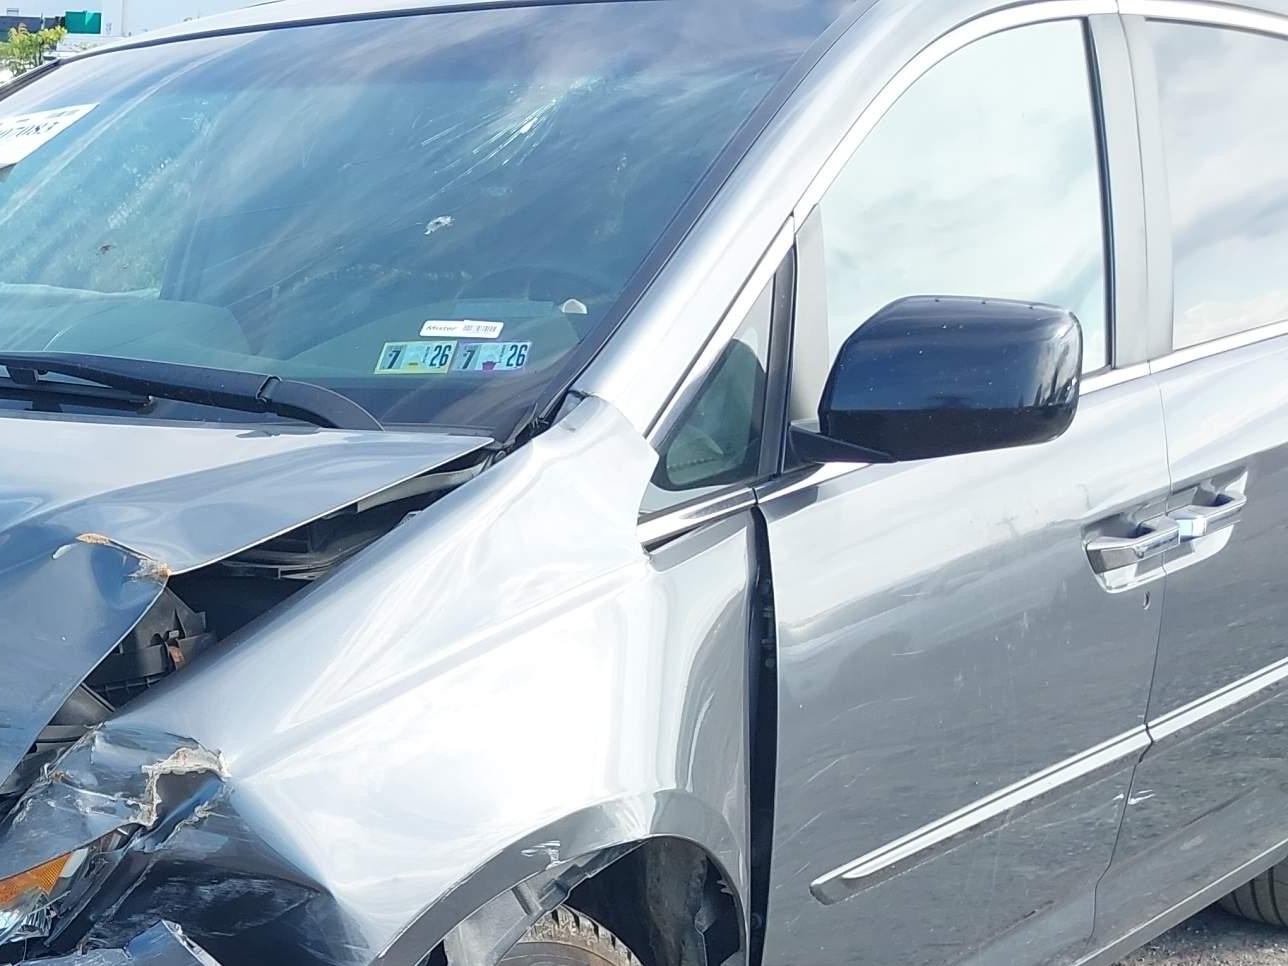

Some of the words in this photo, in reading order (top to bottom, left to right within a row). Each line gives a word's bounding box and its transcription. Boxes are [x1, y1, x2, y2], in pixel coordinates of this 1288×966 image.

[388, 350, 401, 370] 7
[429, 344, 452, 367] 26
[462, 350, 476, 370] 7
[505, 344, 528, 367] 26
